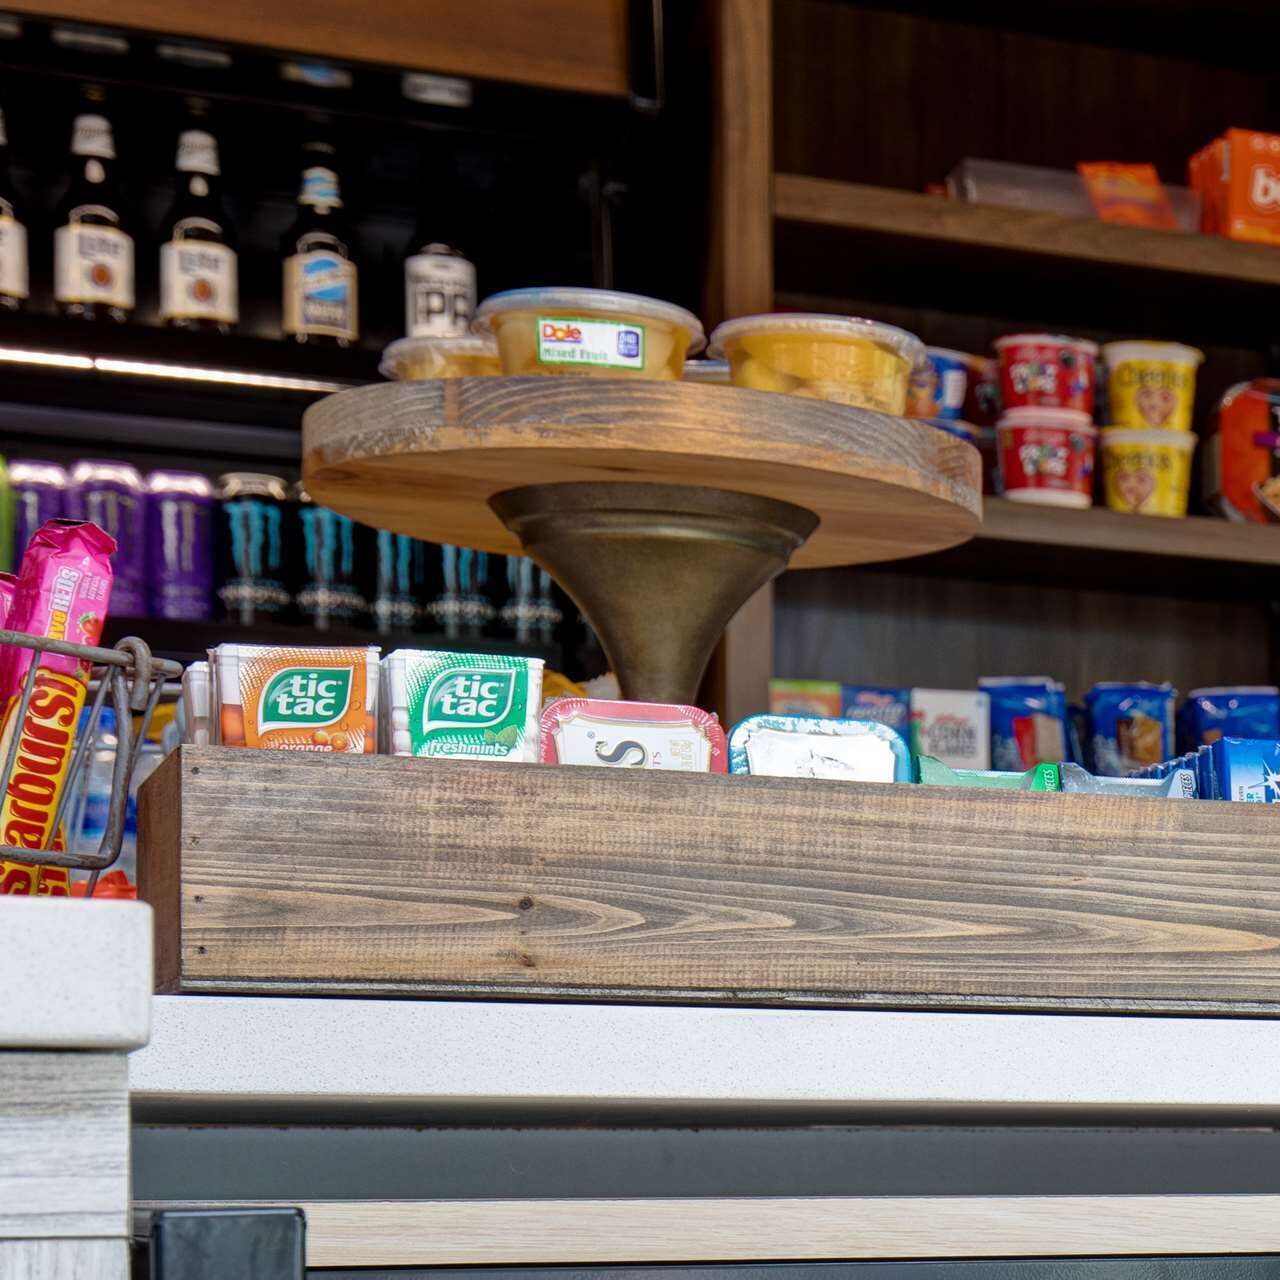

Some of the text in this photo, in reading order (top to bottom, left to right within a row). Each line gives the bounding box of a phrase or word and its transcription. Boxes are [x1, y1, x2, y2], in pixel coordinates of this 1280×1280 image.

[543, 323, 582, 341] Dole
[542, 347, 608, 360] Mixed Fruit
[289, 674, 337, 698] tic
[452, 674, 499, 698] tic
[277, 694, 337, 716] tac
[440, 695, 498, 717] tac
[429, 739, 509, 757] freshmints
